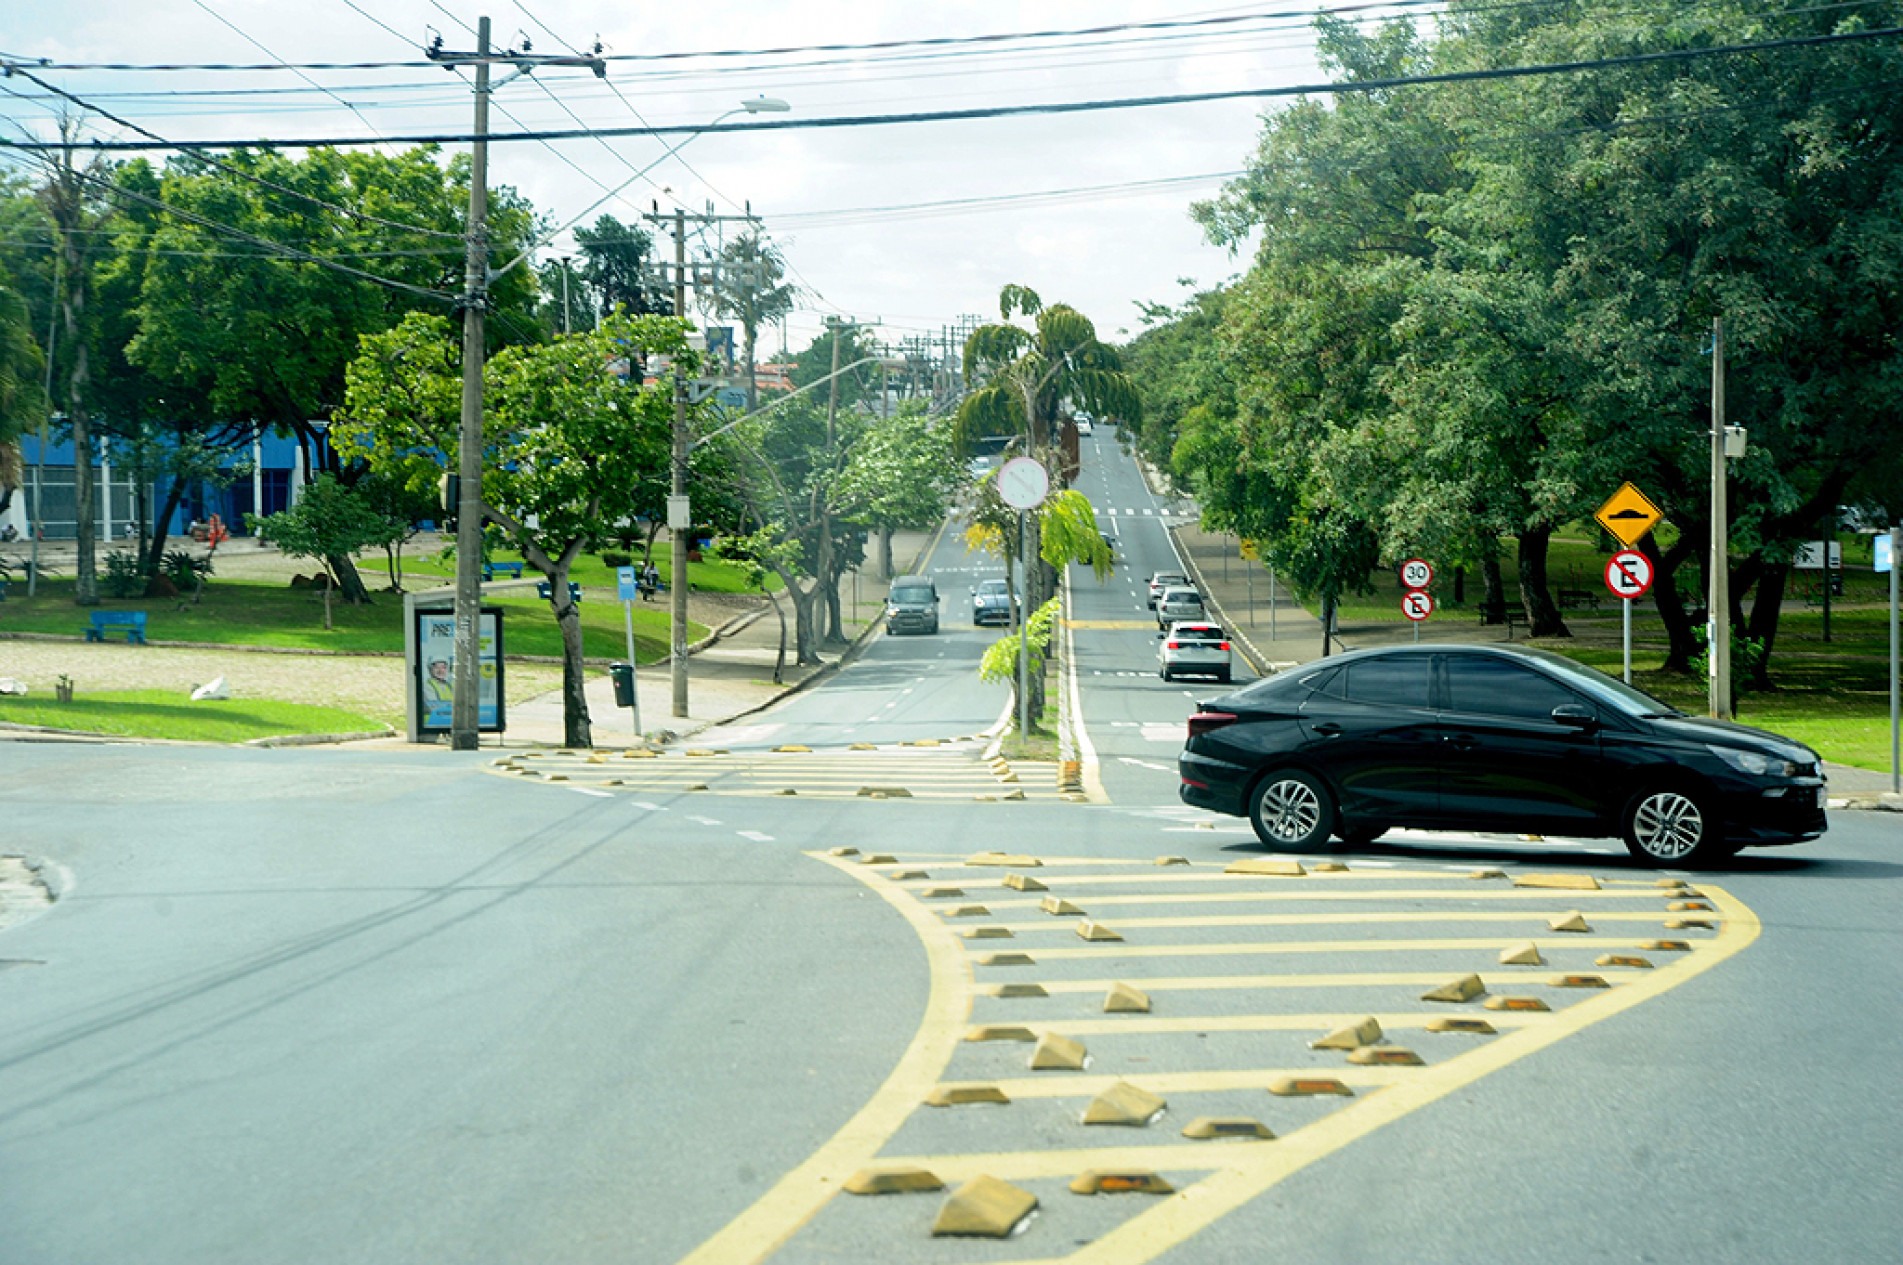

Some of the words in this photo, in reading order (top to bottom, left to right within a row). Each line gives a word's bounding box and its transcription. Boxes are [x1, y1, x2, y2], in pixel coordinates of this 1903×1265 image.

[1406, 566, 1426, 579] 30
[1621, 560, 1639, 587] E
[1411, 595, 1425, 613] E
